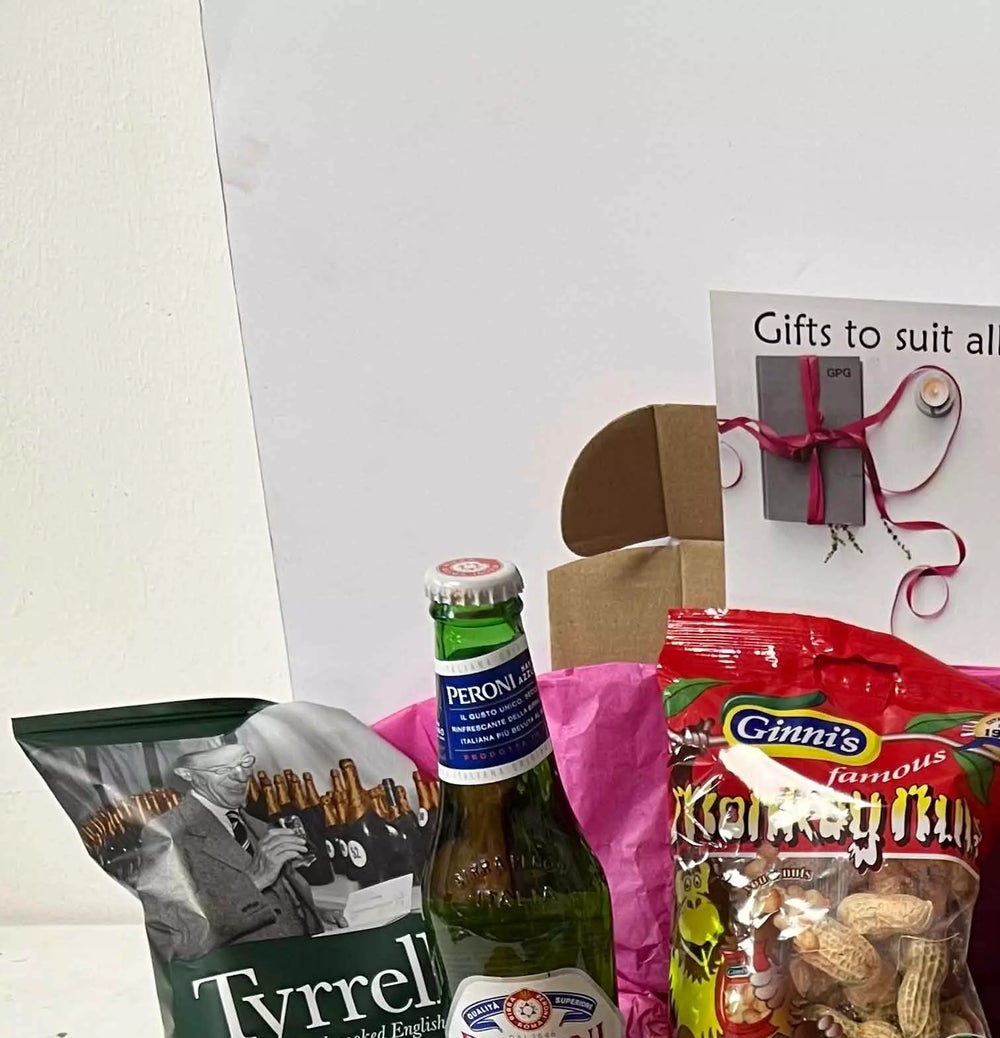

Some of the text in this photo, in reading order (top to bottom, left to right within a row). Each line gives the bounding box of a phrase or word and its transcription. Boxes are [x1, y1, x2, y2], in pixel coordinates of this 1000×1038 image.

[754, 311, 831, 347] Gifts
[845, 319, 881, 349] to
[896, 322, 953, 353] suit
[826, 368, 852, 378] GPG
[446, 673, 517, 706] PERONI
[736, 714, 861, 753] Ginni's
[827, 749, 947, 786] famous
